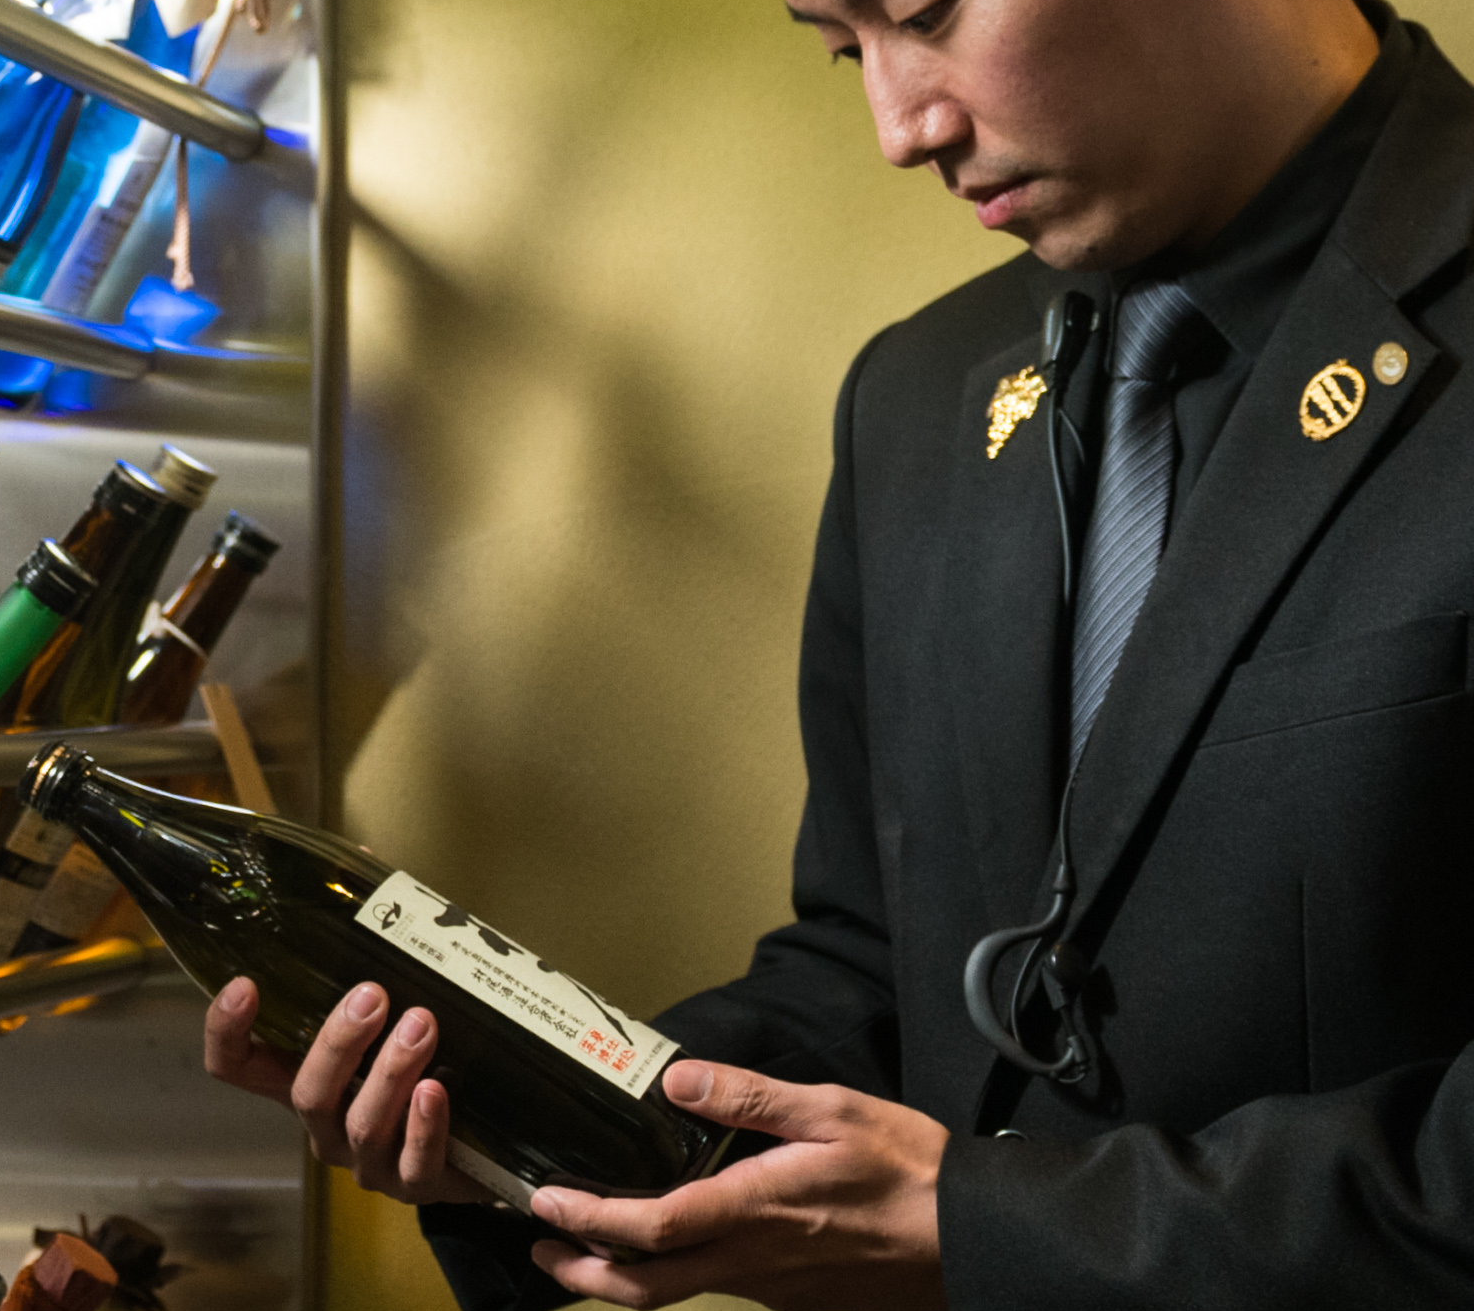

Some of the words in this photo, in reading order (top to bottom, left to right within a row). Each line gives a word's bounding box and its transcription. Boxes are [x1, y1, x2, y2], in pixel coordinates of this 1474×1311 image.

[469, 966, 581, 1042] 村尾酒造合資会社
